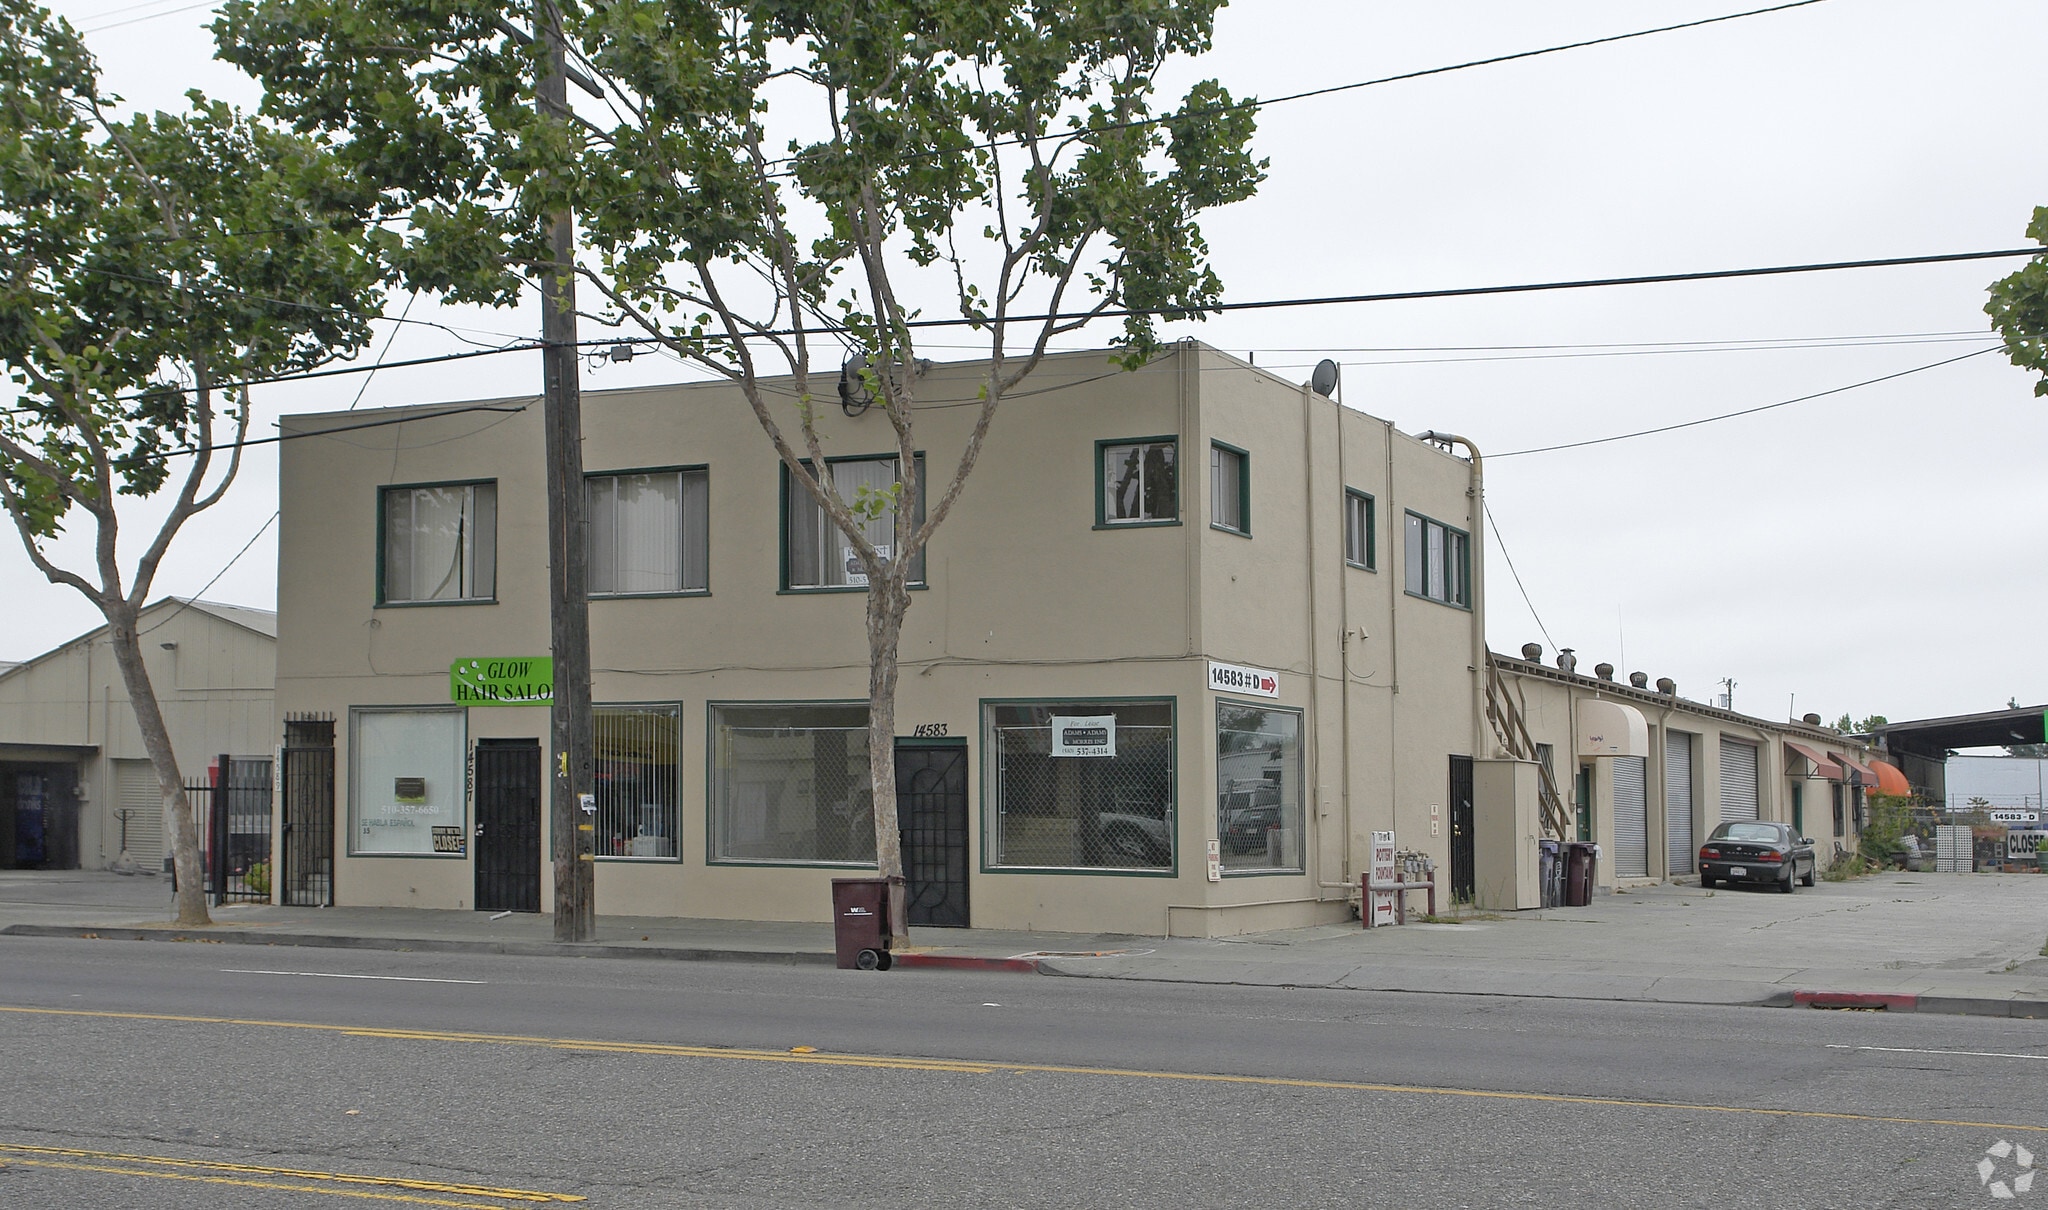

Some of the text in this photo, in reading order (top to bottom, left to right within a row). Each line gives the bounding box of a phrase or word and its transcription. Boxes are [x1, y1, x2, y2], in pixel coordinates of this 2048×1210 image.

[850, 576, 867, 584] 510-5
[487, 661, 533, 679] GLOW
[456, 683, 553, 701] HAIR SALO
[913, 723, 948, 737] 14583
[1076, 747, 1108, 756] 537-4314
[466, 739, 474, 802] 14587
[381, 805, 440, 815] 510-357-6650
